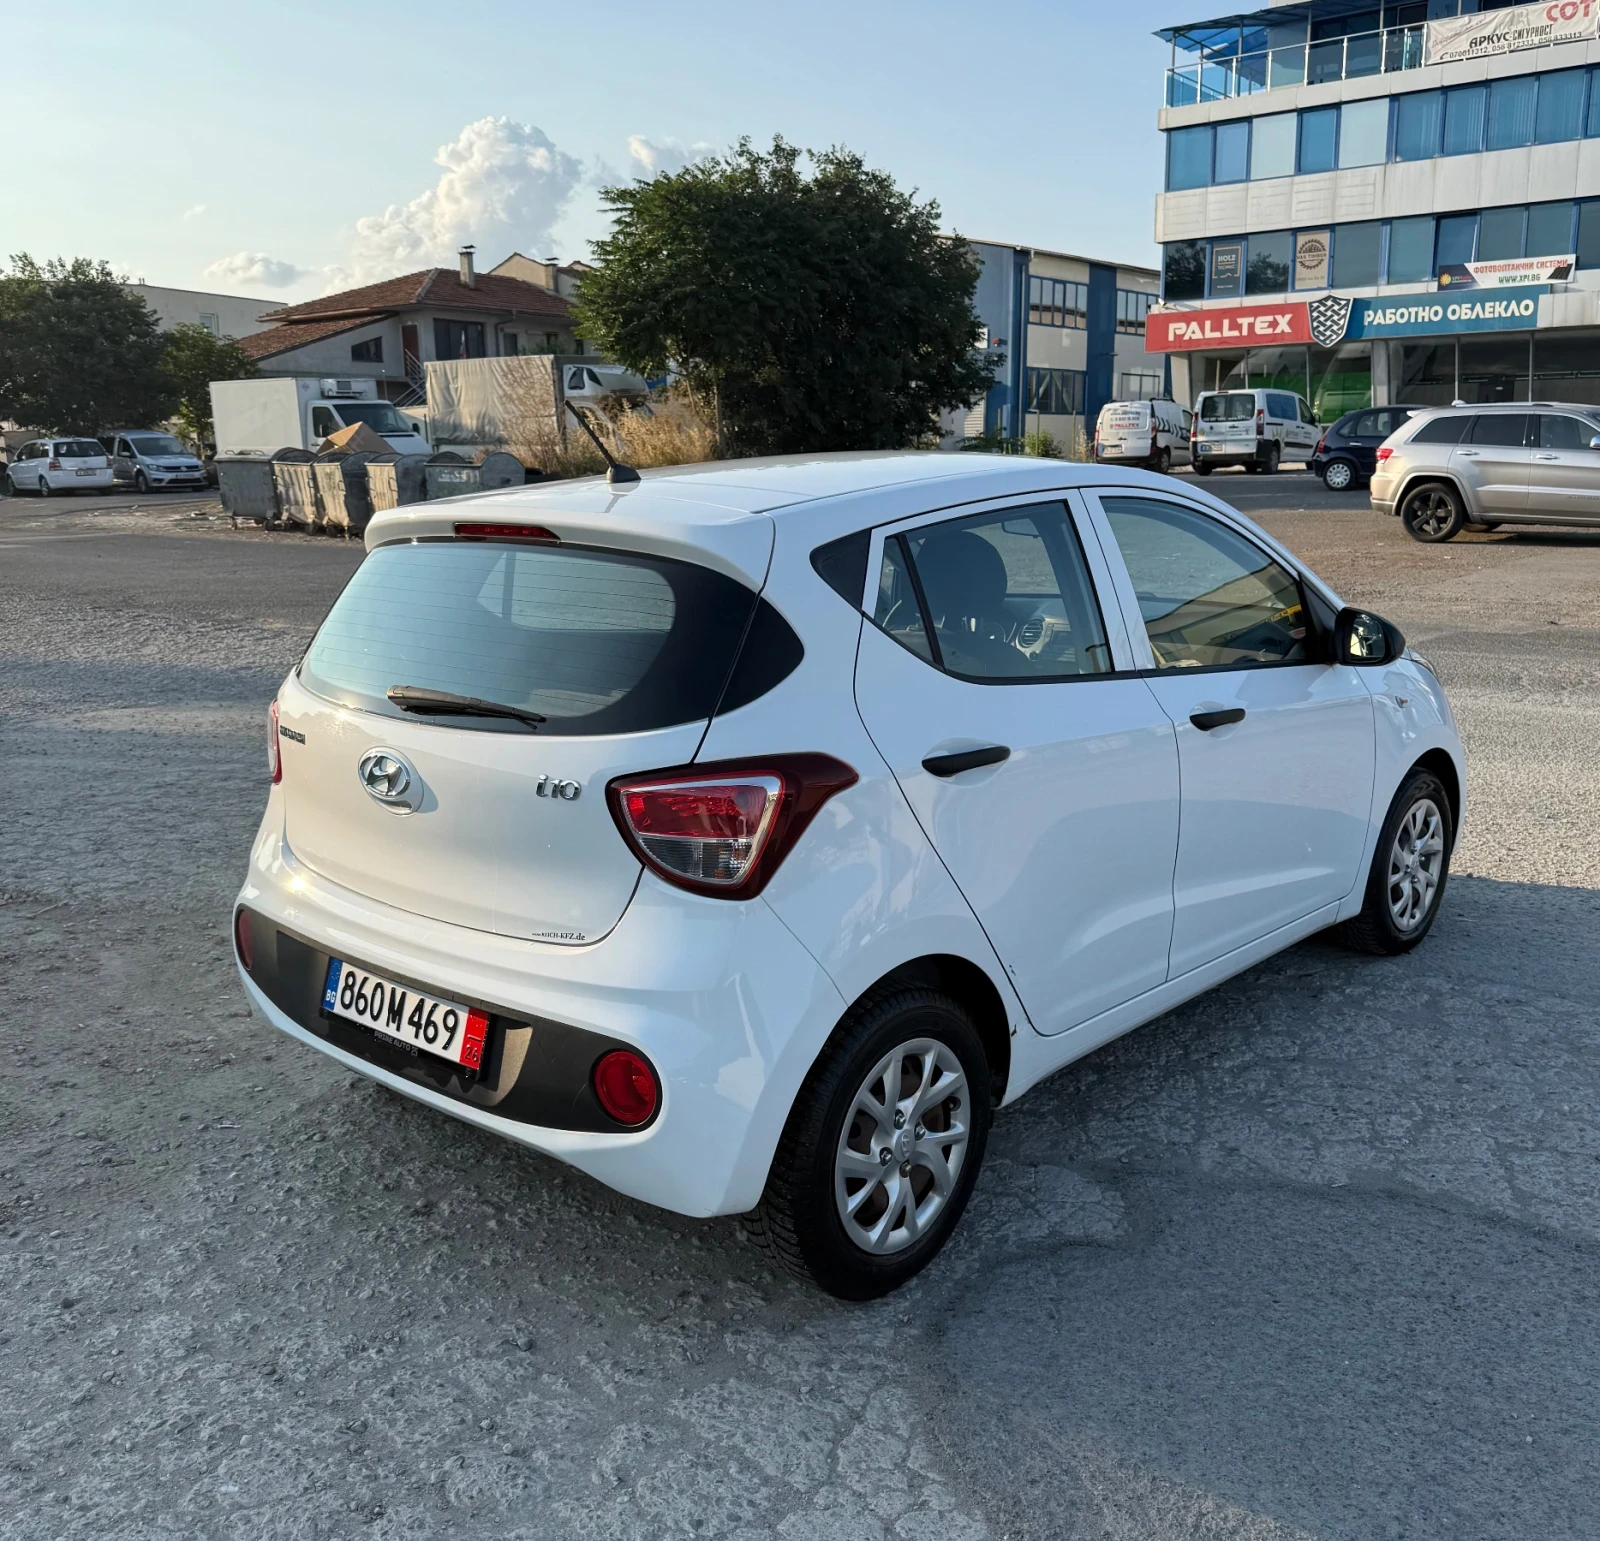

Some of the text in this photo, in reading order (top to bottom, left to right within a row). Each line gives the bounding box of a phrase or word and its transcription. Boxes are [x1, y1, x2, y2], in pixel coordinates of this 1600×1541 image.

[1546, 0, 1596, 22] СОТ
[1536, 258, 1568, 269] СИСТЕМИ
[1498, 273, 1541, 284] WWW.XPI.BG
[1363, 299, 1535, 326] РАБОТНО ОБЛЕКЛО
[1167, 313, 1293, 342] PALLTEX
[536, 774, 582, 801] i10
[325, 989, 337, 1003] BG
